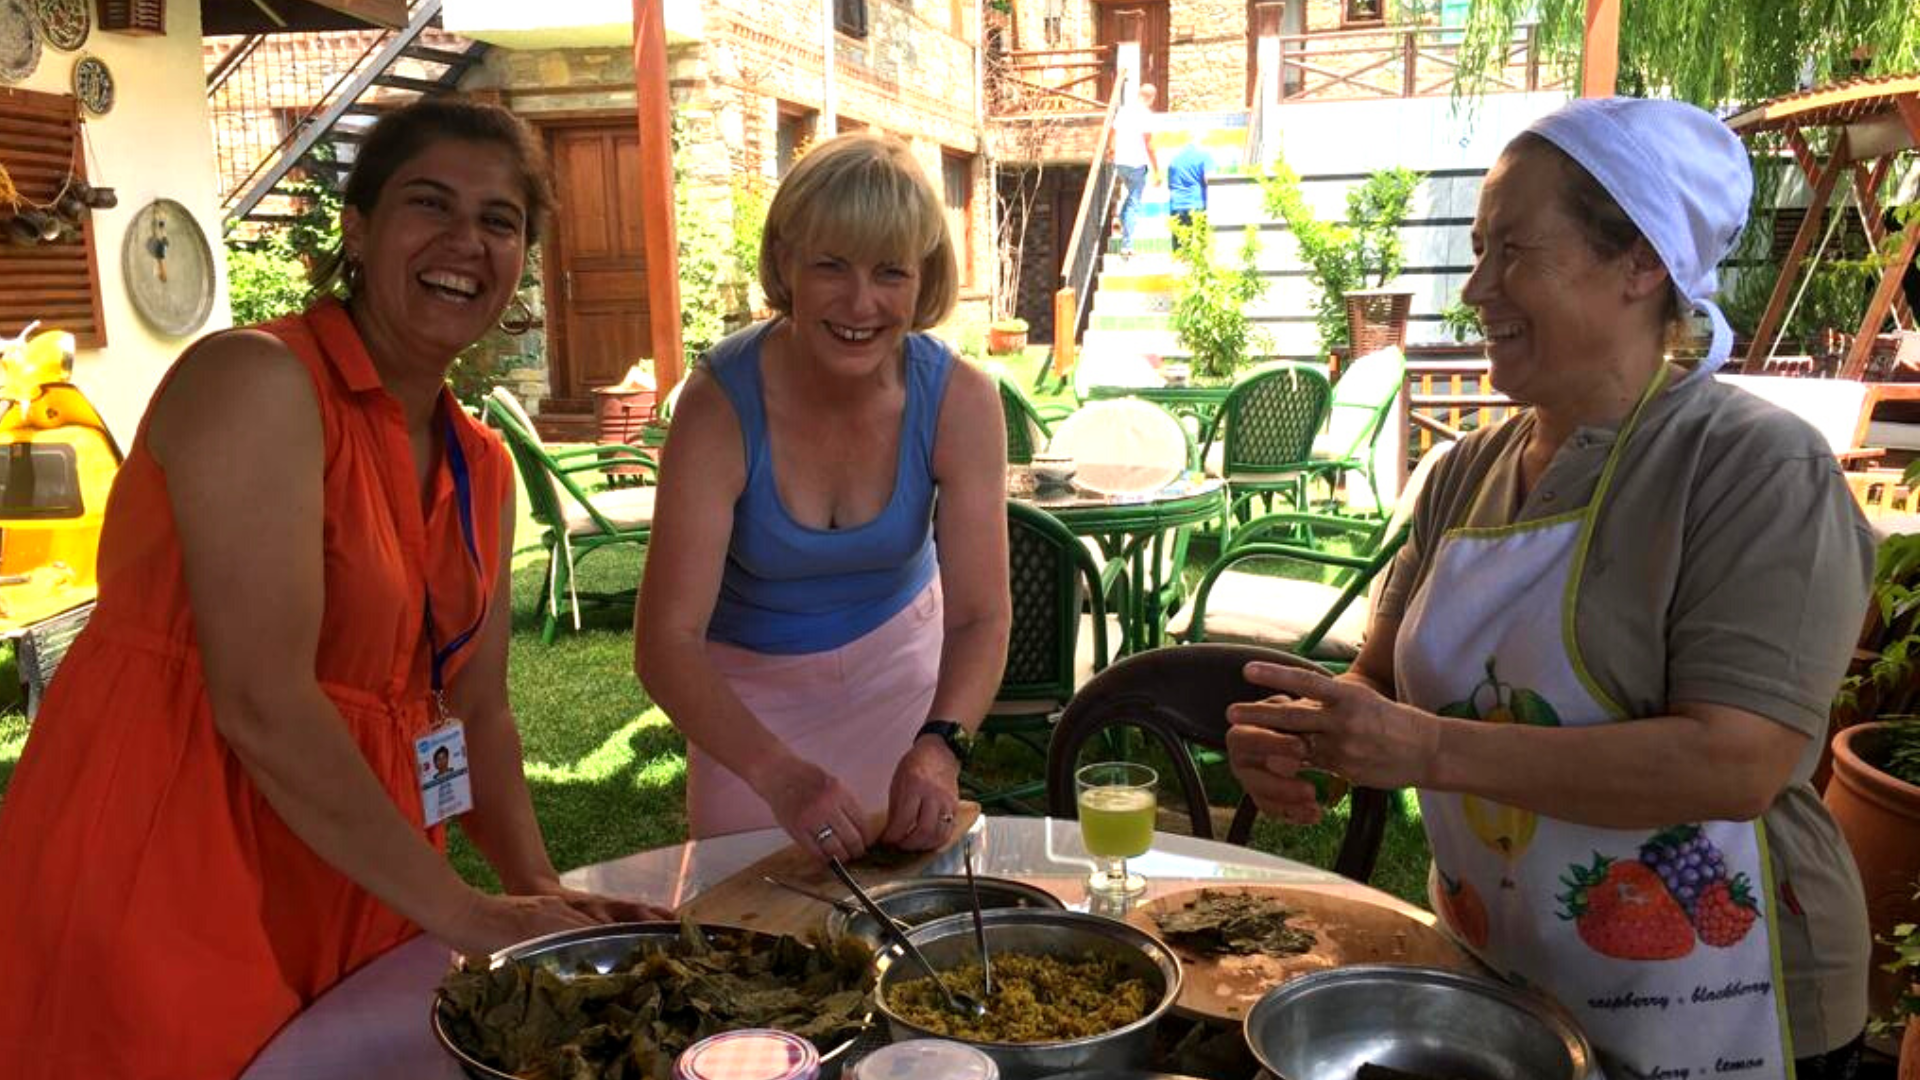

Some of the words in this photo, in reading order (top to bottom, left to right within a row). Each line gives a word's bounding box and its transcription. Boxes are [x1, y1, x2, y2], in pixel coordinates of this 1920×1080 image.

[1587, 991, 1670, 1012] raspberry
[1690, 980, 1771, 1004] blackberry
[1715, 1057, 1765, 1073] lemon
